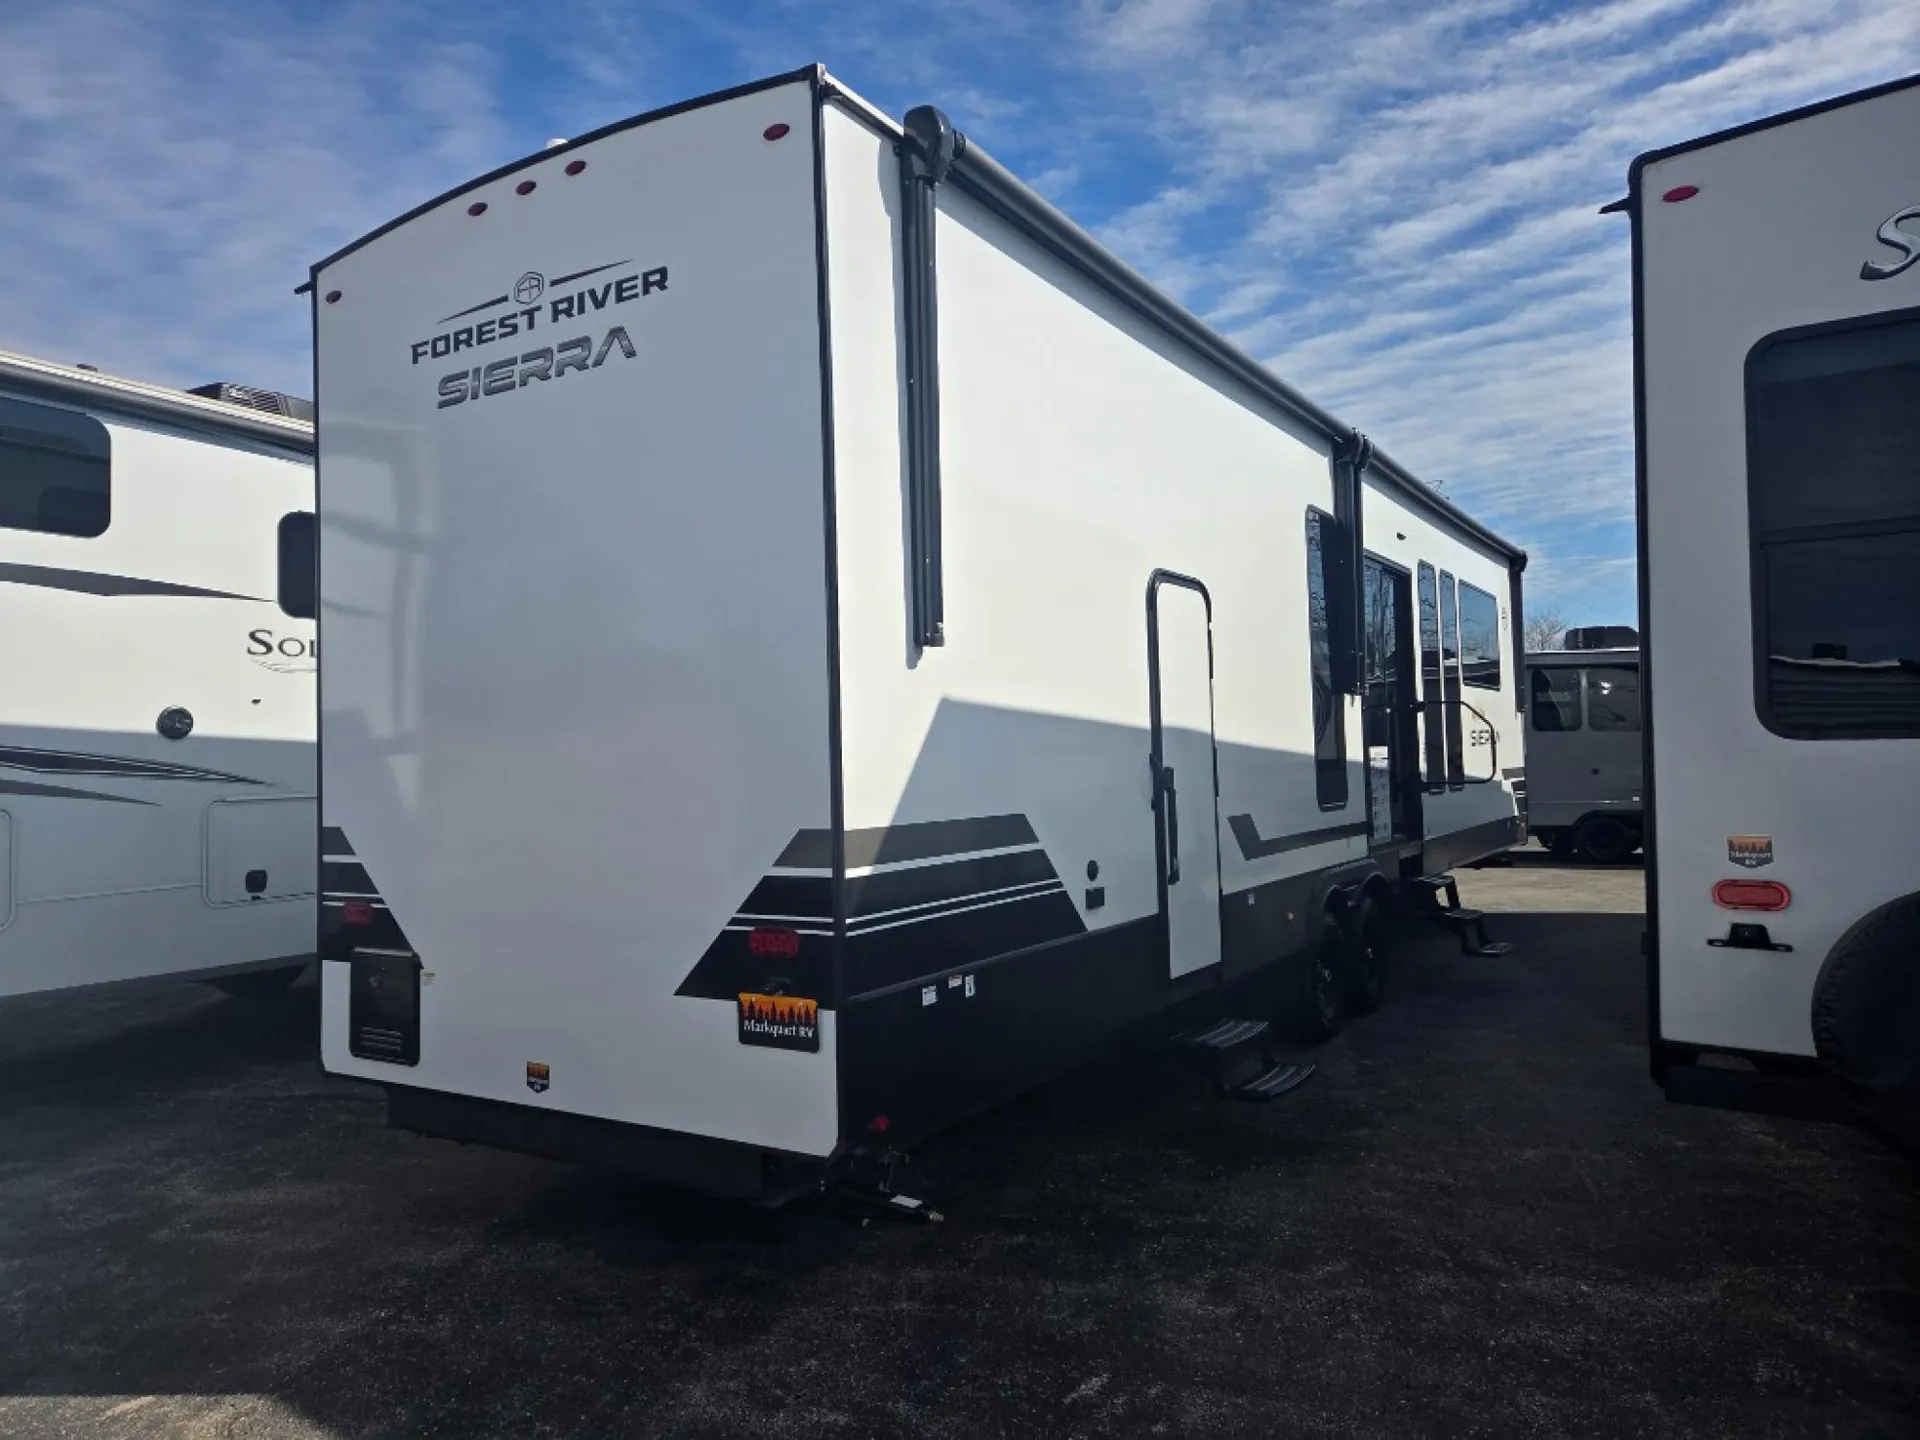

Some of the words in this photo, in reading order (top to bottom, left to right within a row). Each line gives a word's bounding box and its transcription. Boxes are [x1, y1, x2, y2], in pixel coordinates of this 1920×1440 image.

[410, 304, 542, 365] FOREST
[549, 265, 669, 323] RIVER
[436, 325, 638, 410] SIERRA
[743, 1019, 797, 1038] Markquart
[798, 1026, 815, 1038] RV
